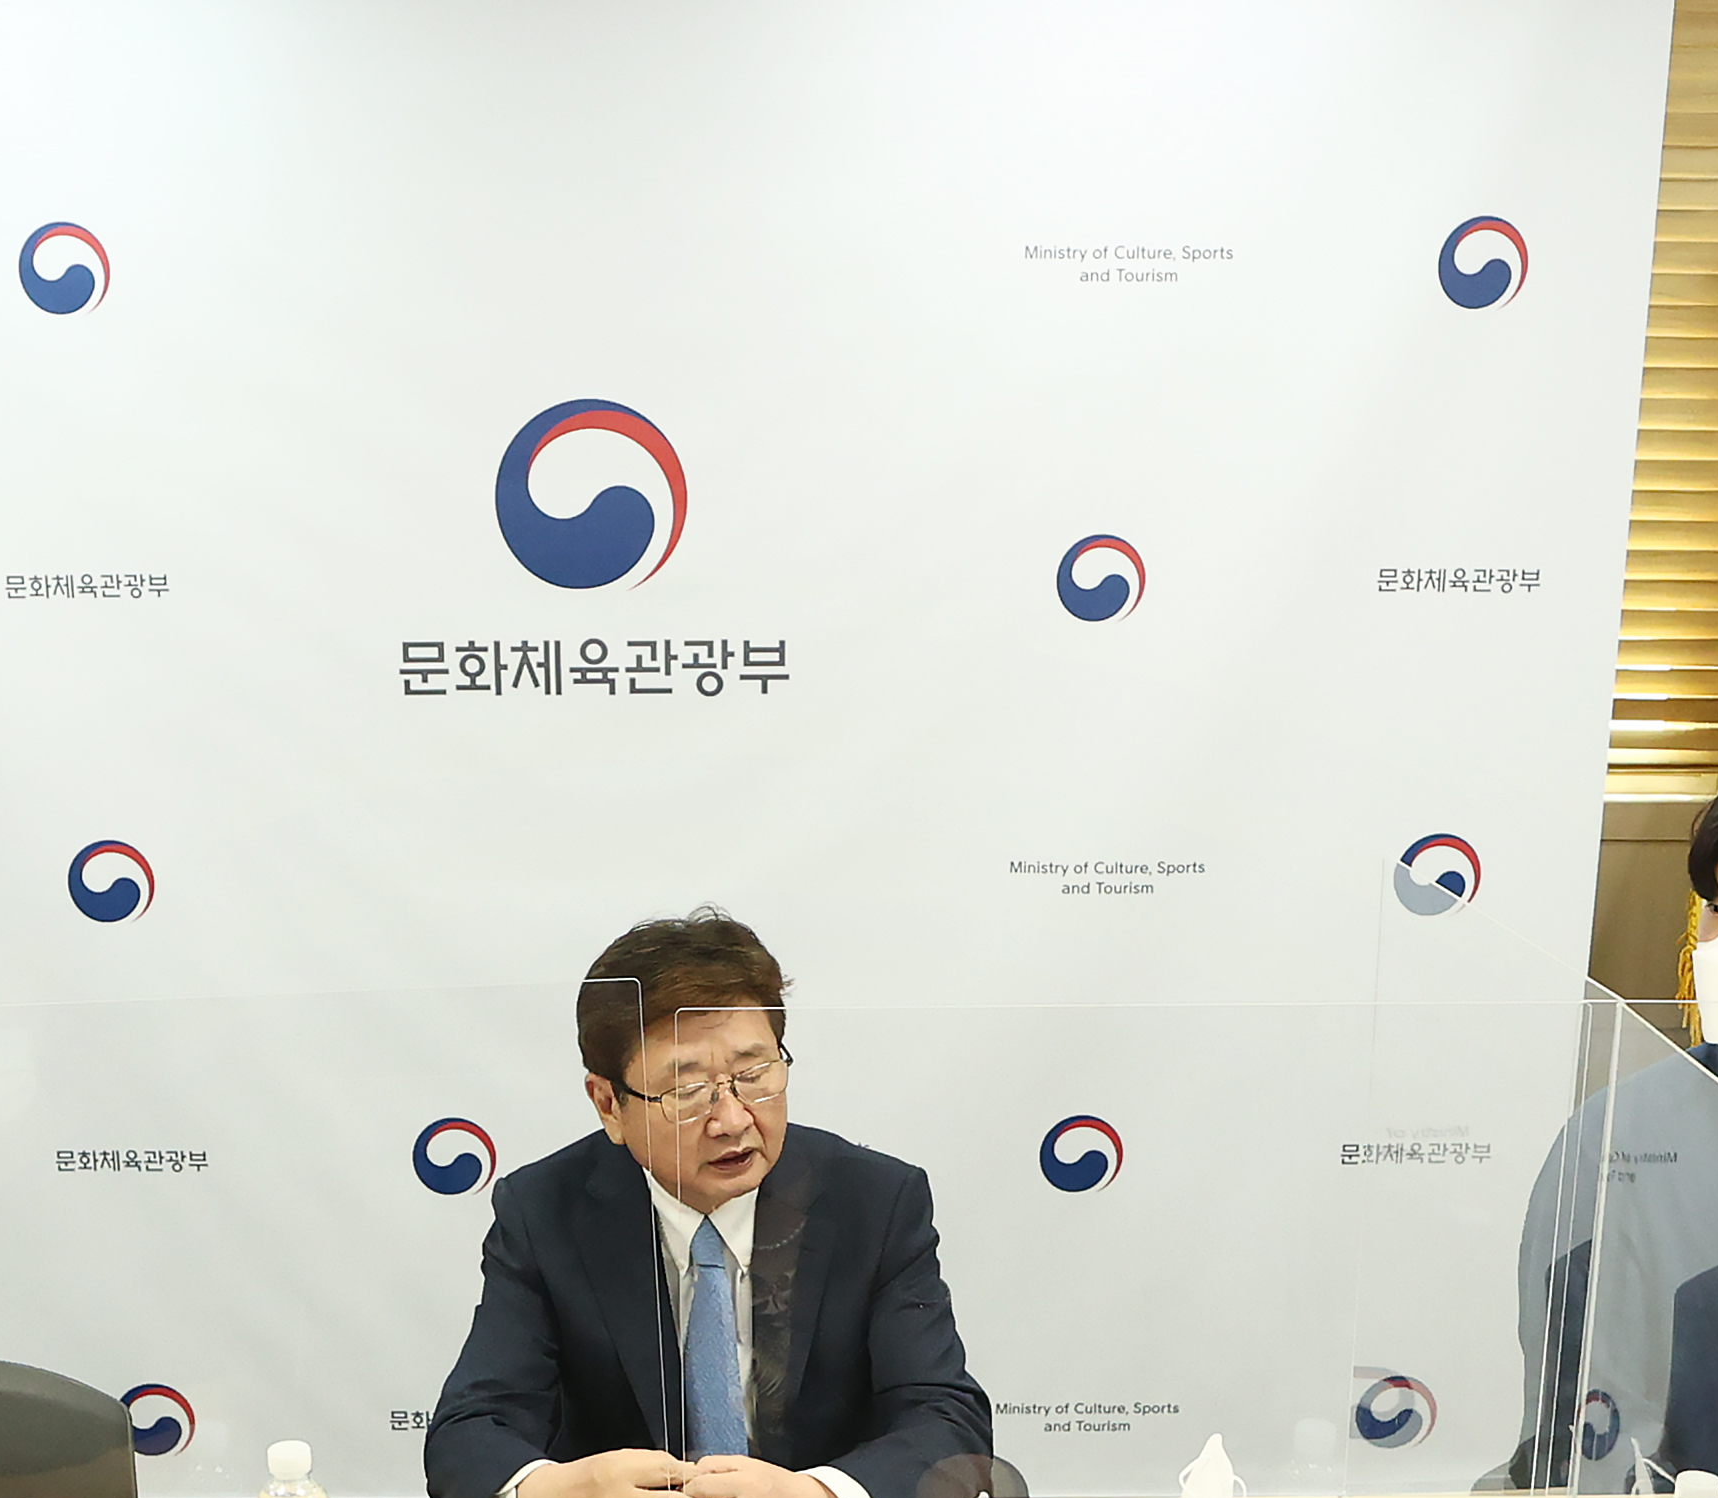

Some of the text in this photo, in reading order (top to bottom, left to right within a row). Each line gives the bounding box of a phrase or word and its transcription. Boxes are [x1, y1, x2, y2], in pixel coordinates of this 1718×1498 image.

[1024, 245, 1234, 264] Ministry of Culture, Sports
[1079, 268, 1179, 283] and Tourism
[4, 573, 170, 599] 문화체육관광부
[1376, 567, 1541, 595] 문화체육관광부
[398, 637, 791, 698] 문화체육관광부
[1009, 860, 1206, 878] Ministry of Culture, Sports
[1060, 880, 1155, 895] and Tourism
[55, 1149, 210, 1174] 문화체육관광부
[994, 1401, 1180, 1418] Ministry of Culture, Sports
[1043, 1419, 1131, 1433] and Tourism
